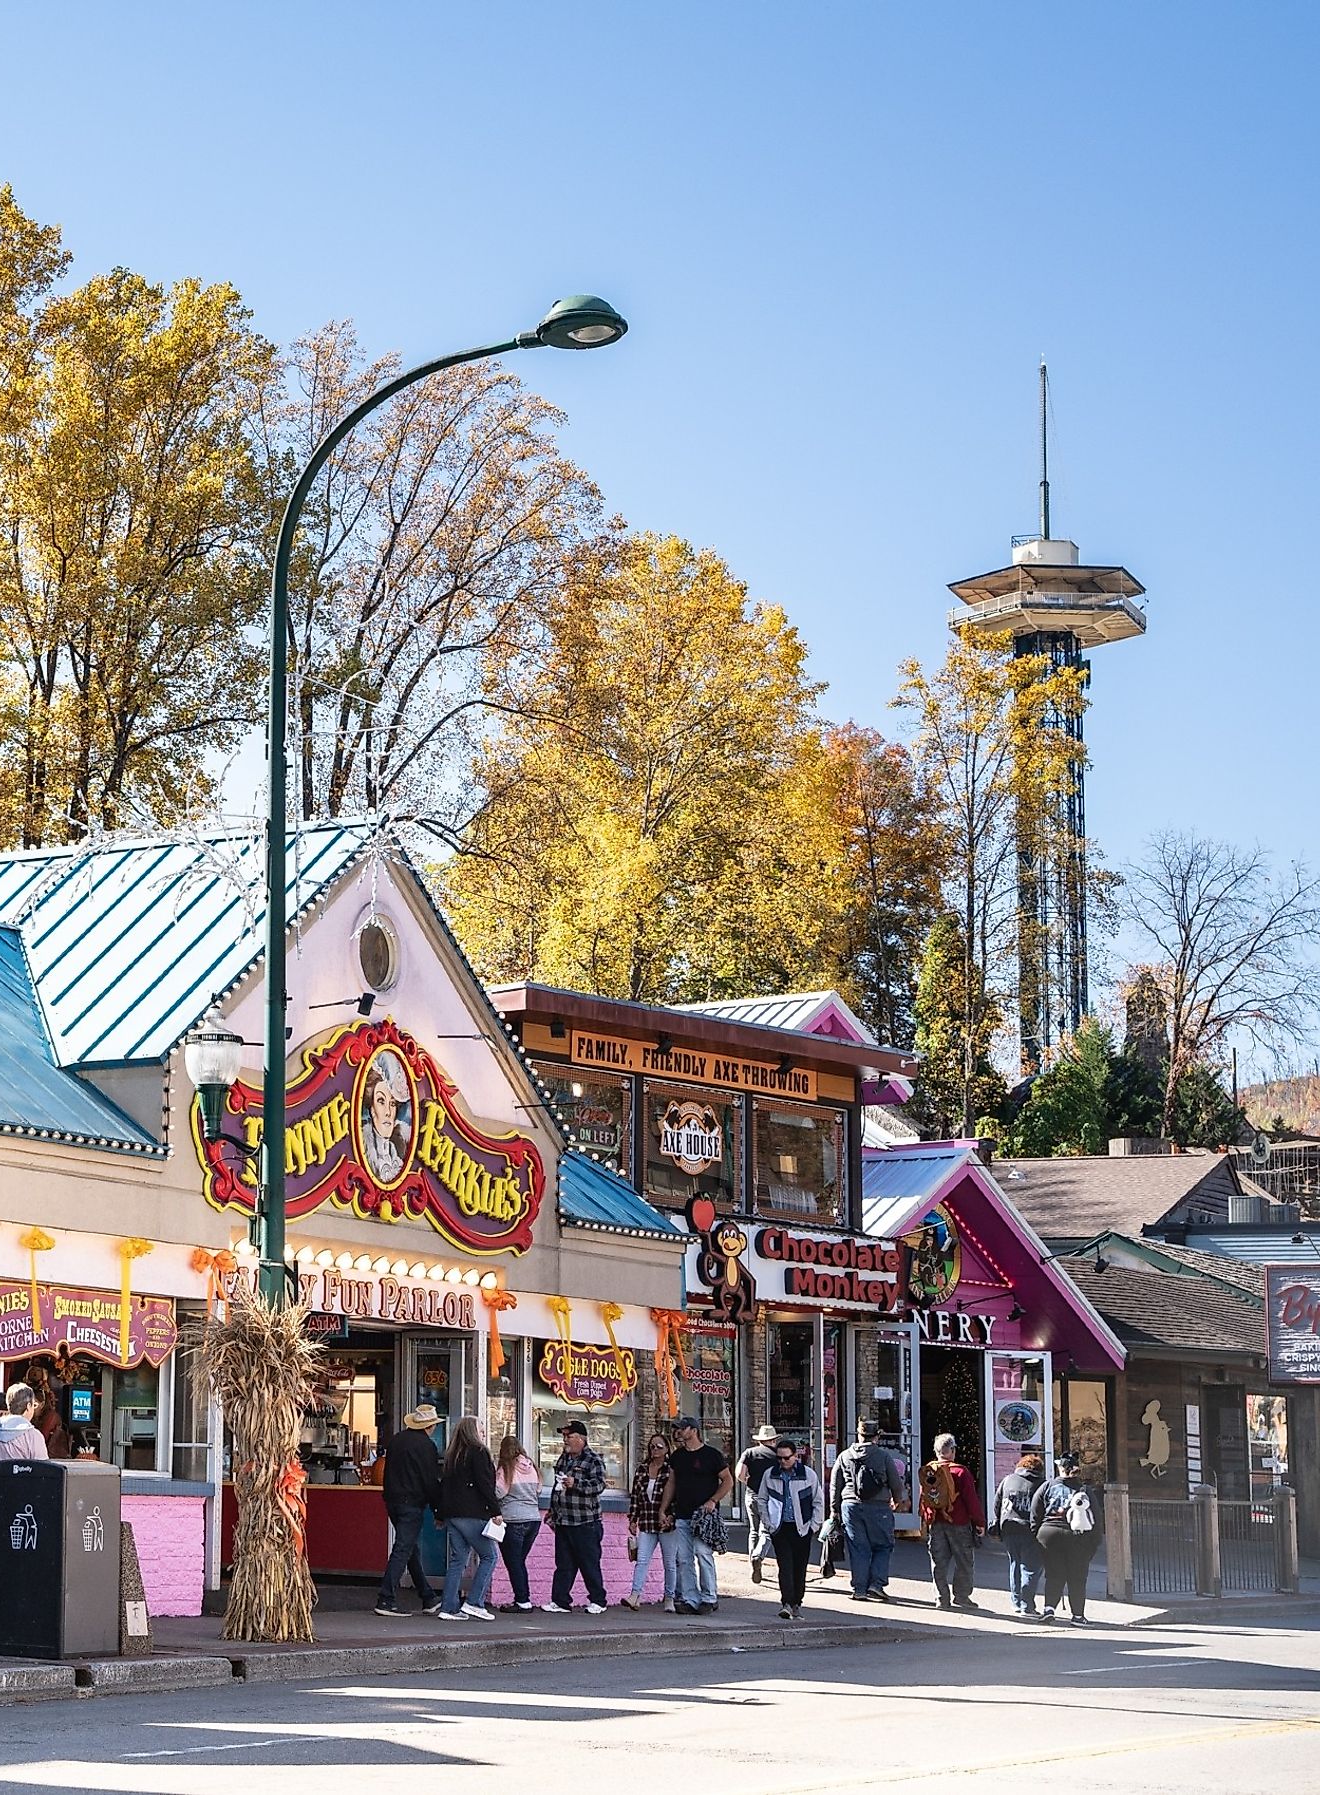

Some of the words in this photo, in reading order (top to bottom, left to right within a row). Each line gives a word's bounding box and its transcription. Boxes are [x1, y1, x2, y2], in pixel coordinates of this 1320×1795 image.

[642, 1047, 707, 1079] FRIENDLY
[713, 1059, 740, 1084] AXE
[742, 1064, 810, 1096] THROWING
[579, 1127, 592, 1142] ON
[593, 1130, 615, 1145] LEFT
[663, 1130, 683, 1154] AXE
[686, 1133, 720, 1158] HOUSE
[417, 1100, 522, 1221] FARKLE'S
[760, 1226, 900, 1272] Chocolate
[379, 1276, 476, 1328] PARLOR
[790, 1266, 900, 1312] Monkey
[54, 1295, 92, 1320] SMOKED
[308, 1315, 342, 1330] ATM
[66, 1320, 136, 1357] CHEESESTEK
[73, 1396, 91, 1407] ATM
[692, 1382, 730, 1399] Monkey
